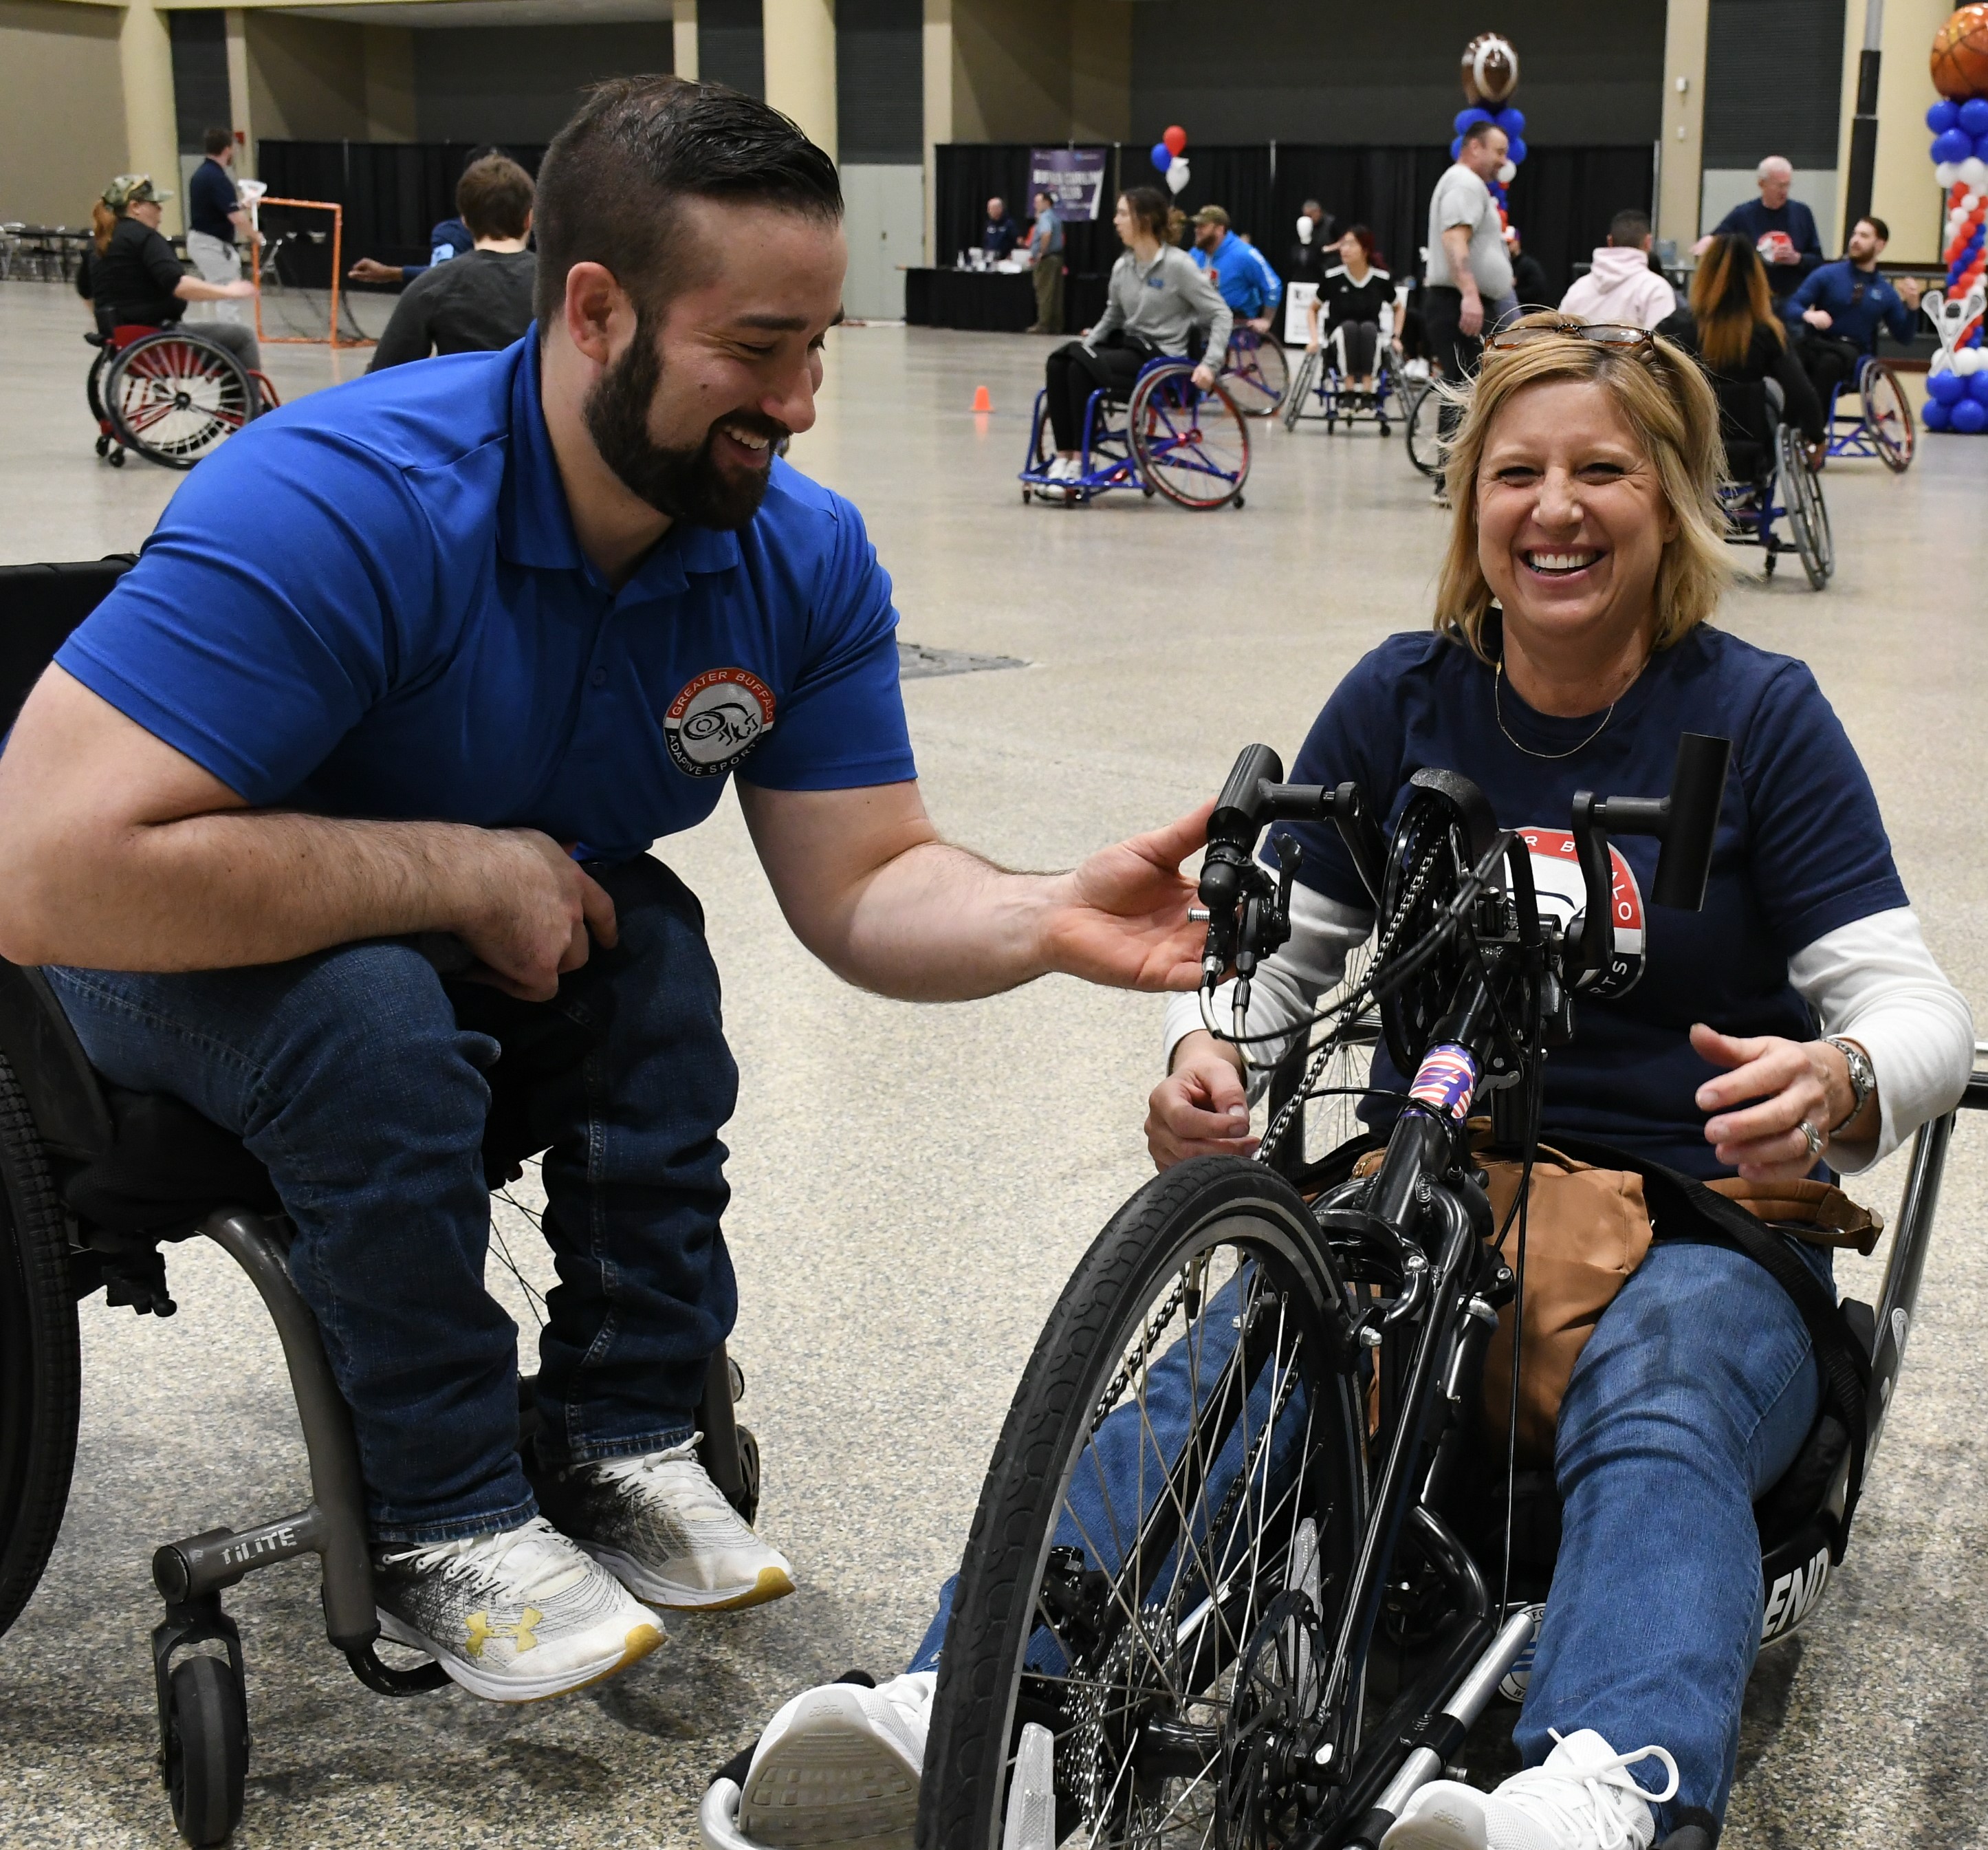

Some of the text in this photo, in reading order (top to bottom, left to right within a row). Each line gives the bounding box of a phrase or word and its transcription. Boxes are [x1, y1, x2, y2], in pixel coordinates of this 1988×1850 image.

[672, 671, 774, 720] GREATER BUFFALO
[668, 734, 758, 775] ADAPTIVE SPORT
[1762, 1547, 1829, 1638] END
